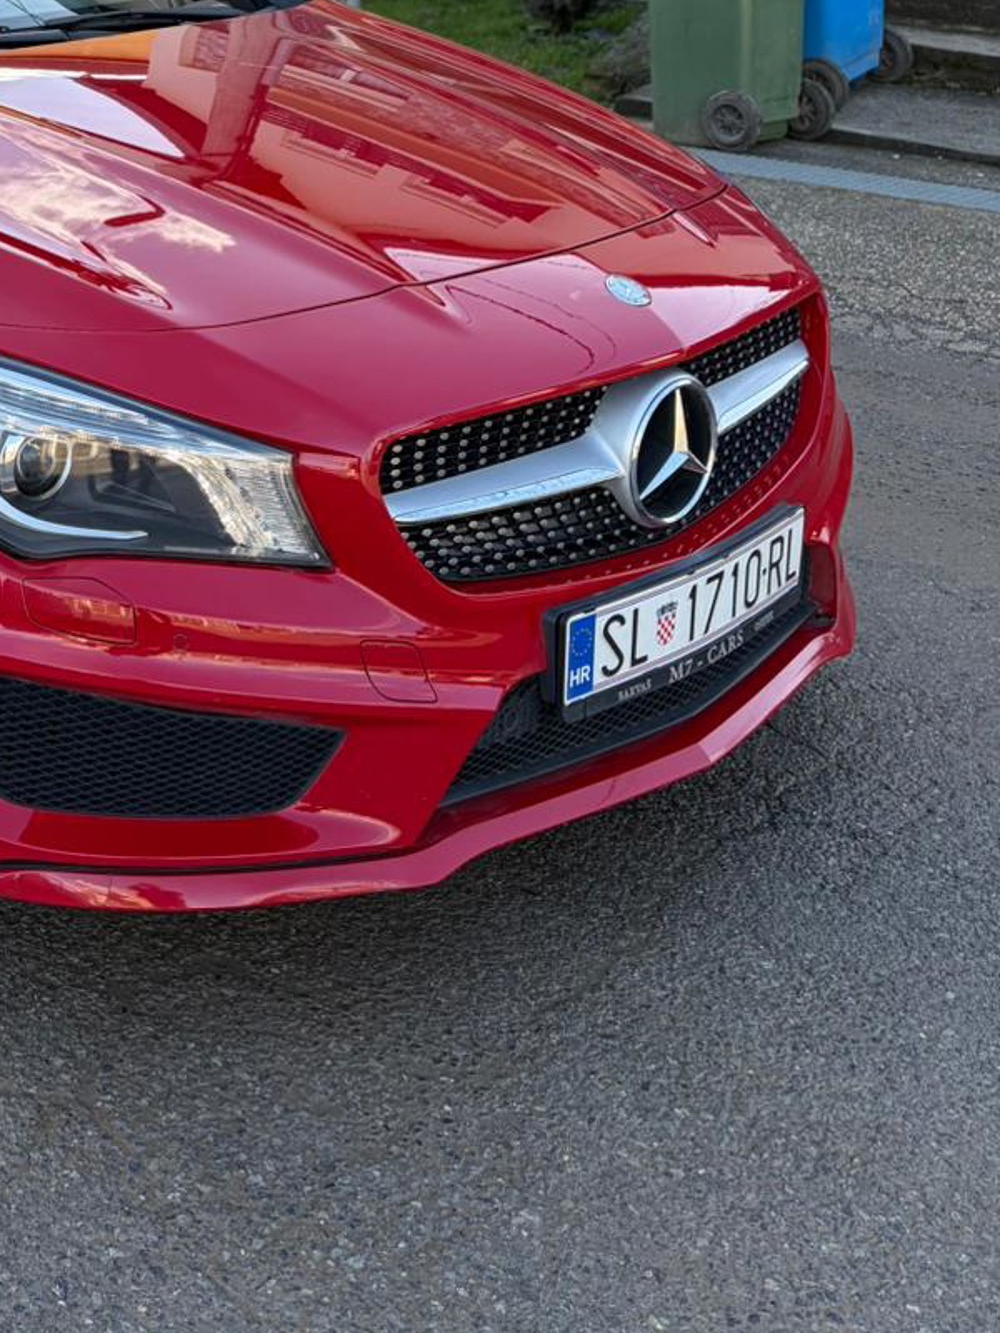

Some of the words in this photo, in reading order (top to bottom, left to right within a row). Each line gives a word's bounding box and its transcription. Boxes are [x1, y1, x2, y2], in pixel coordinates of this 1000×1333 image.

[601, 608, 648, 677] SL
[707, 630, 744, 664] CARS
[569, 665, 591, 688] HR
